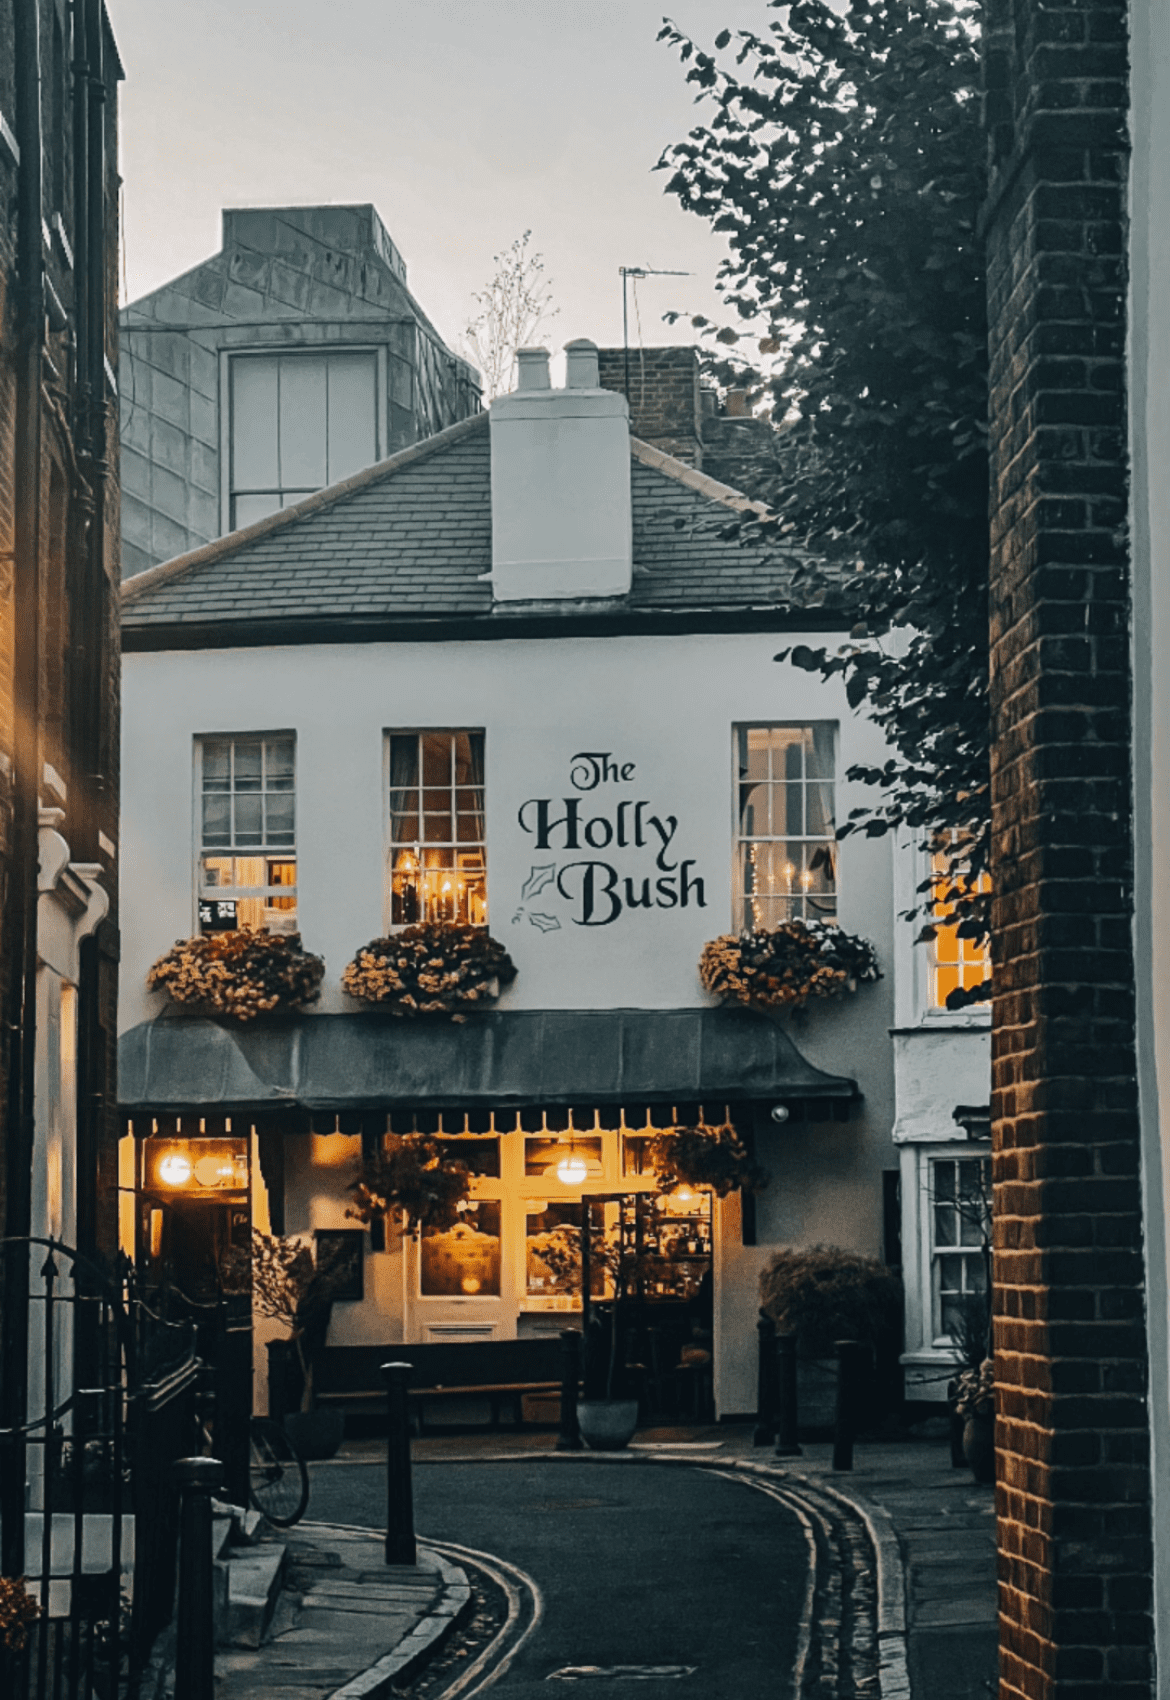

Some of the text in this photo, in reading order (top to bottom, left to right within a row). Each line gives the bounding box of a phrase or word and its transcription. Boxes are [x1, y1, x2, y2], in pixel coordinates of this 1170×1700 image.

[569, 752, 636, 791] The
[517, 797, 679, 873] Holly
[556, 859, 708, 927] Bush
